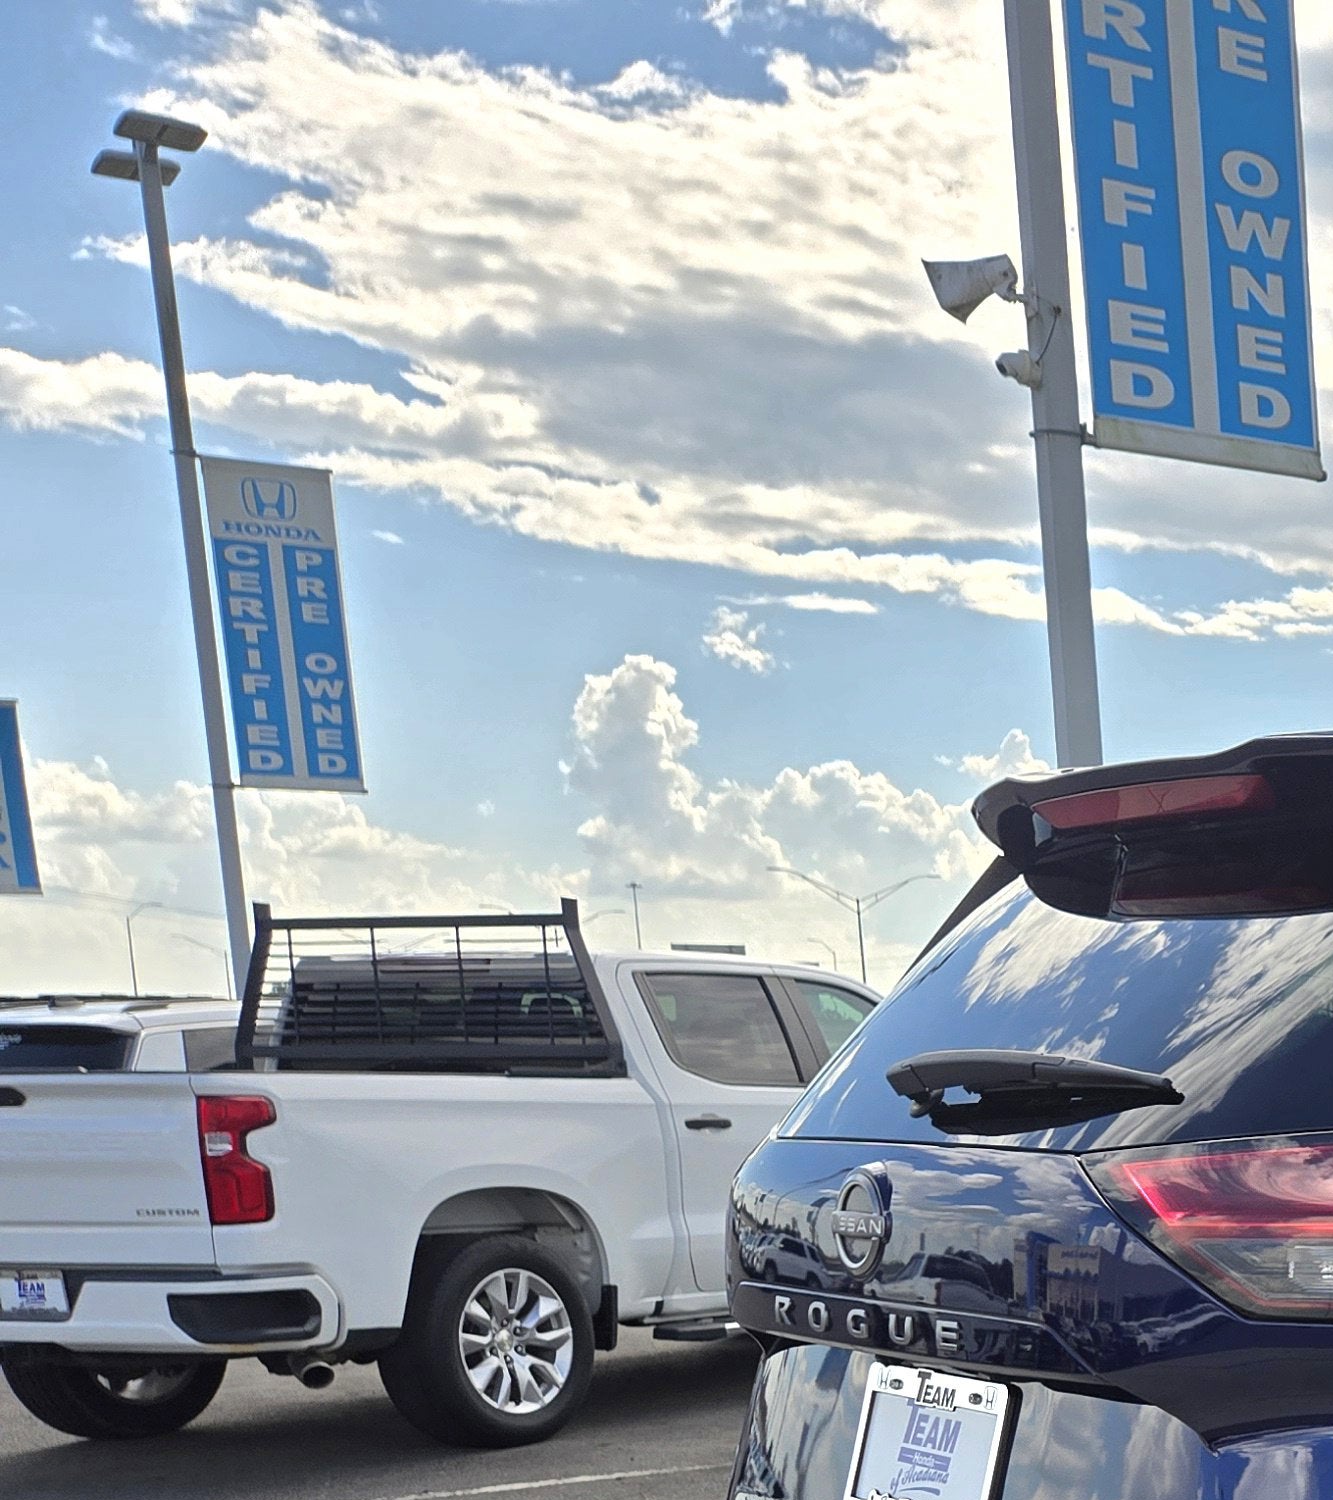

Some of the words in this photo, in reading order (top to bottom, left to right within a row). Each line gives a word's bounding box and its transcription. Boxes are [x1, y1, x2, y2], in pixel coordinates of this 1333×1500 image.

[1214, 150, 1291, 429] OWNED
[222, 521, 321, 541] HONDA
[295, 550, 329, 625] PRE
[224, 544, 284, 772] CERTIFIED
[302, 652, 347, 775] OWNED
[775, 1295, 962, 1351] ROGUE
[917, 1371, 956, 1408] TEAM
[902, 1400, 962, 1453] TEAM
